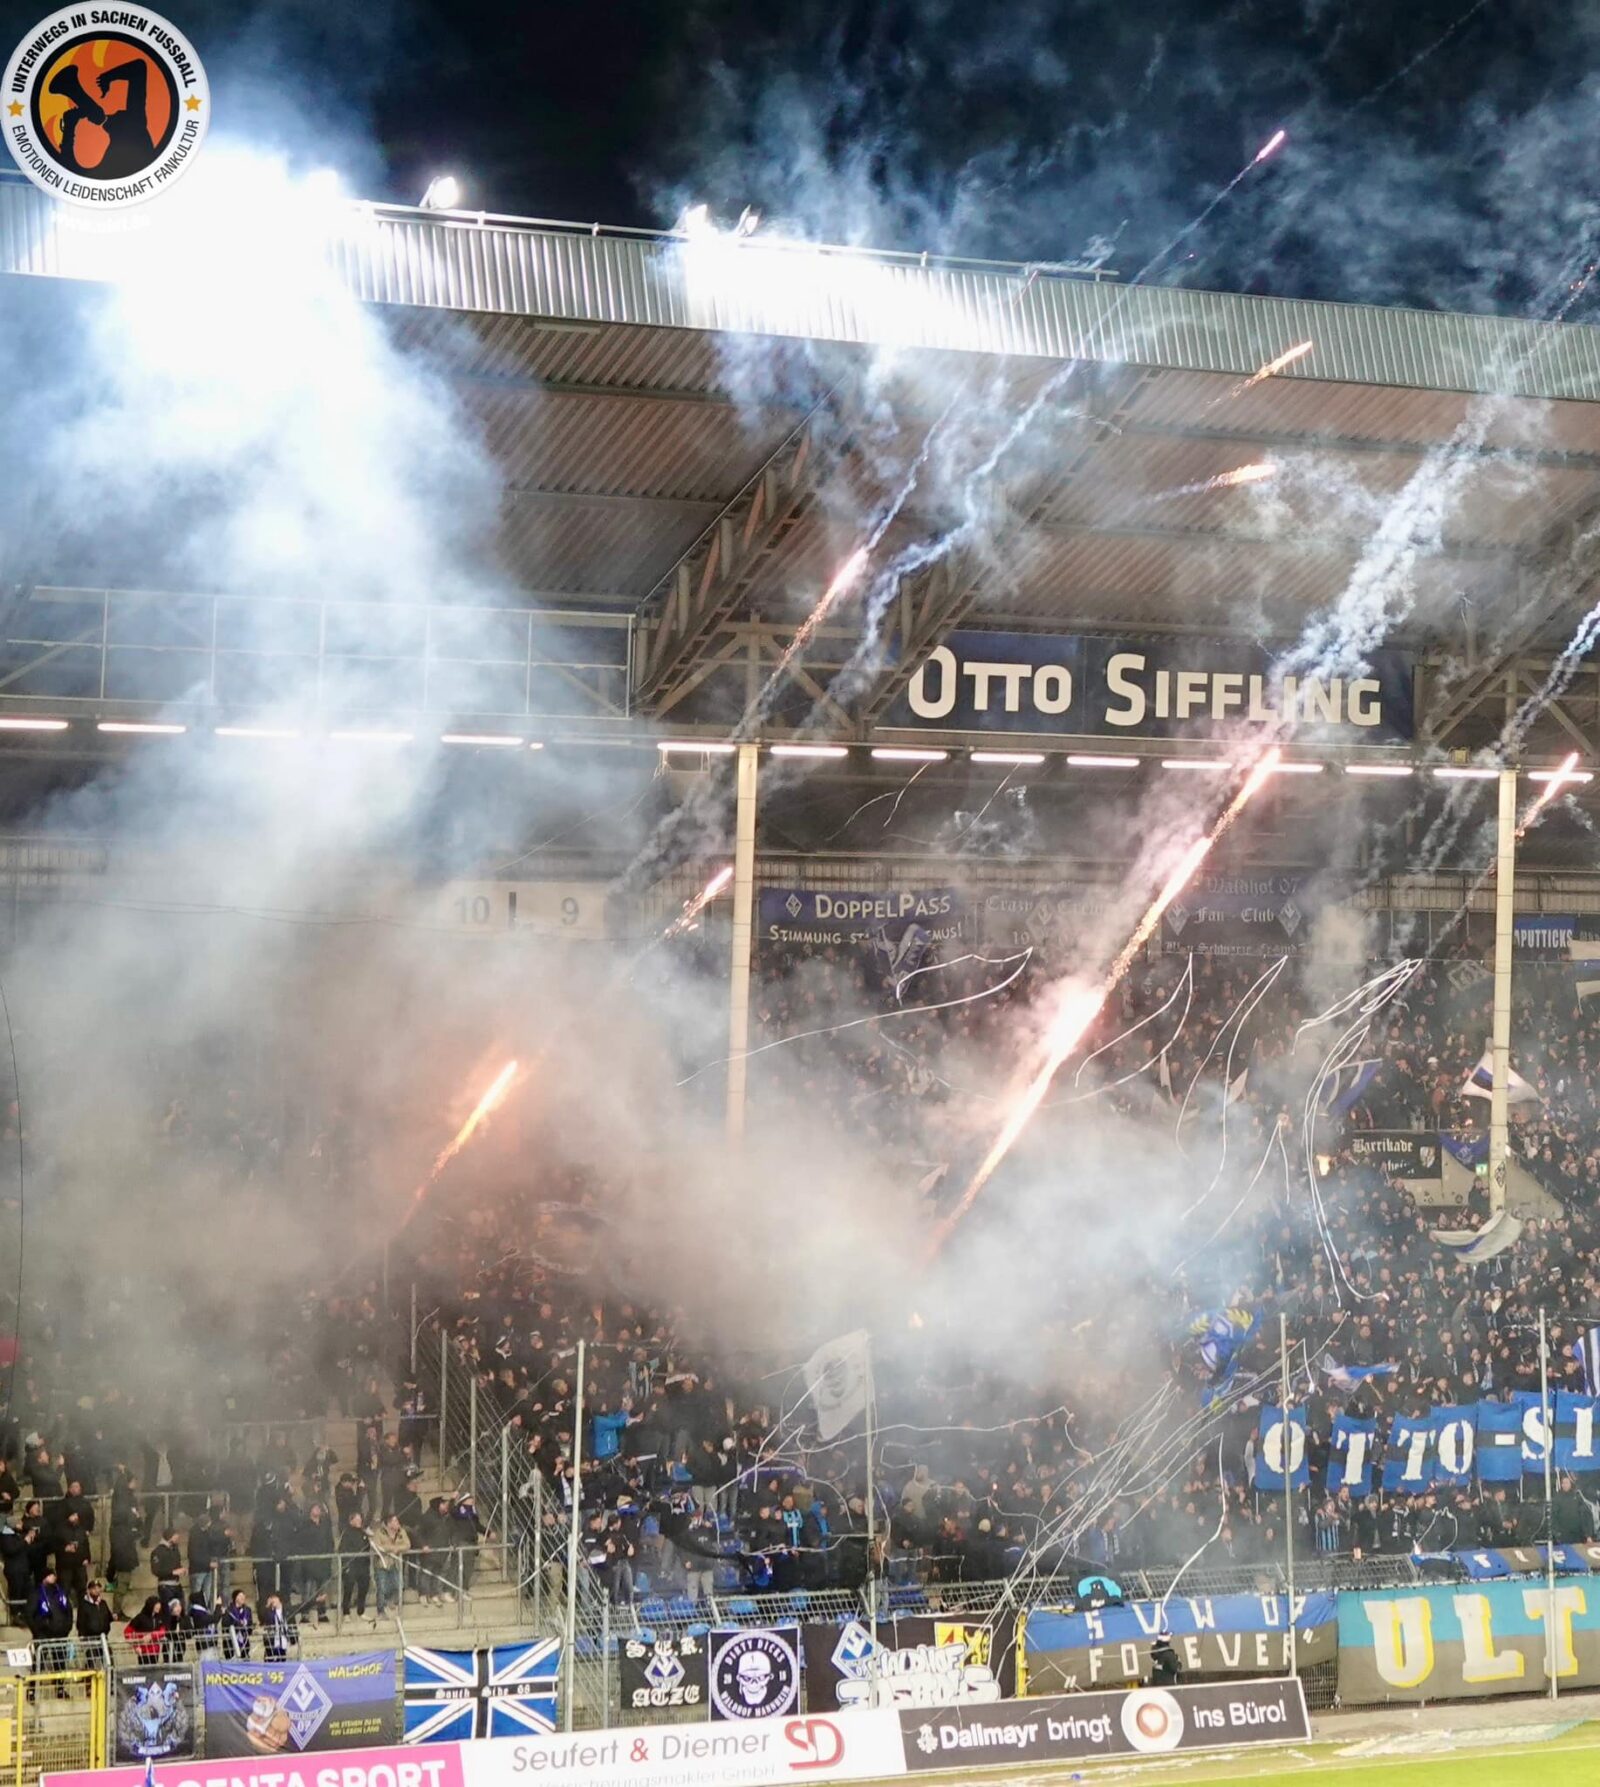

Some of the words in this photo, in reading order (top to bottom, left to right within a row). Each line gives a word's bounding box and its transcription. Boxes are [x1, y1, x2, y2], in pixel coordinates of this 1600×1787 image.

[908, 644, 1072, 719] OTTO
[1104, 653, 1381, 727] SIFFLING
[453, 895, 491, 924] 10
[561, 896, 579, 926] 9
[815, 892, 951, 919] DOPPELPASS
[1241, 907, 1275, 923] Club
[770, 925, 841, 944] STIMMUNG
[1352, 1137, 1413, 1154] Barrikade
[329, 1663, 383, 1679] WALDHOF
[1193, 1705, 1225, 1728] ins
[1230, 1698, 1286, 1725] Büro!
[939, 1721, 1038, 1750] Dallmayr
[1047, 1713, 1113, 1744] bringt
[512, 1738, 618, 1772] Seufert
[630, 1738, 649, 1762] &
[662, 1731, 771, 1760] Diemer
